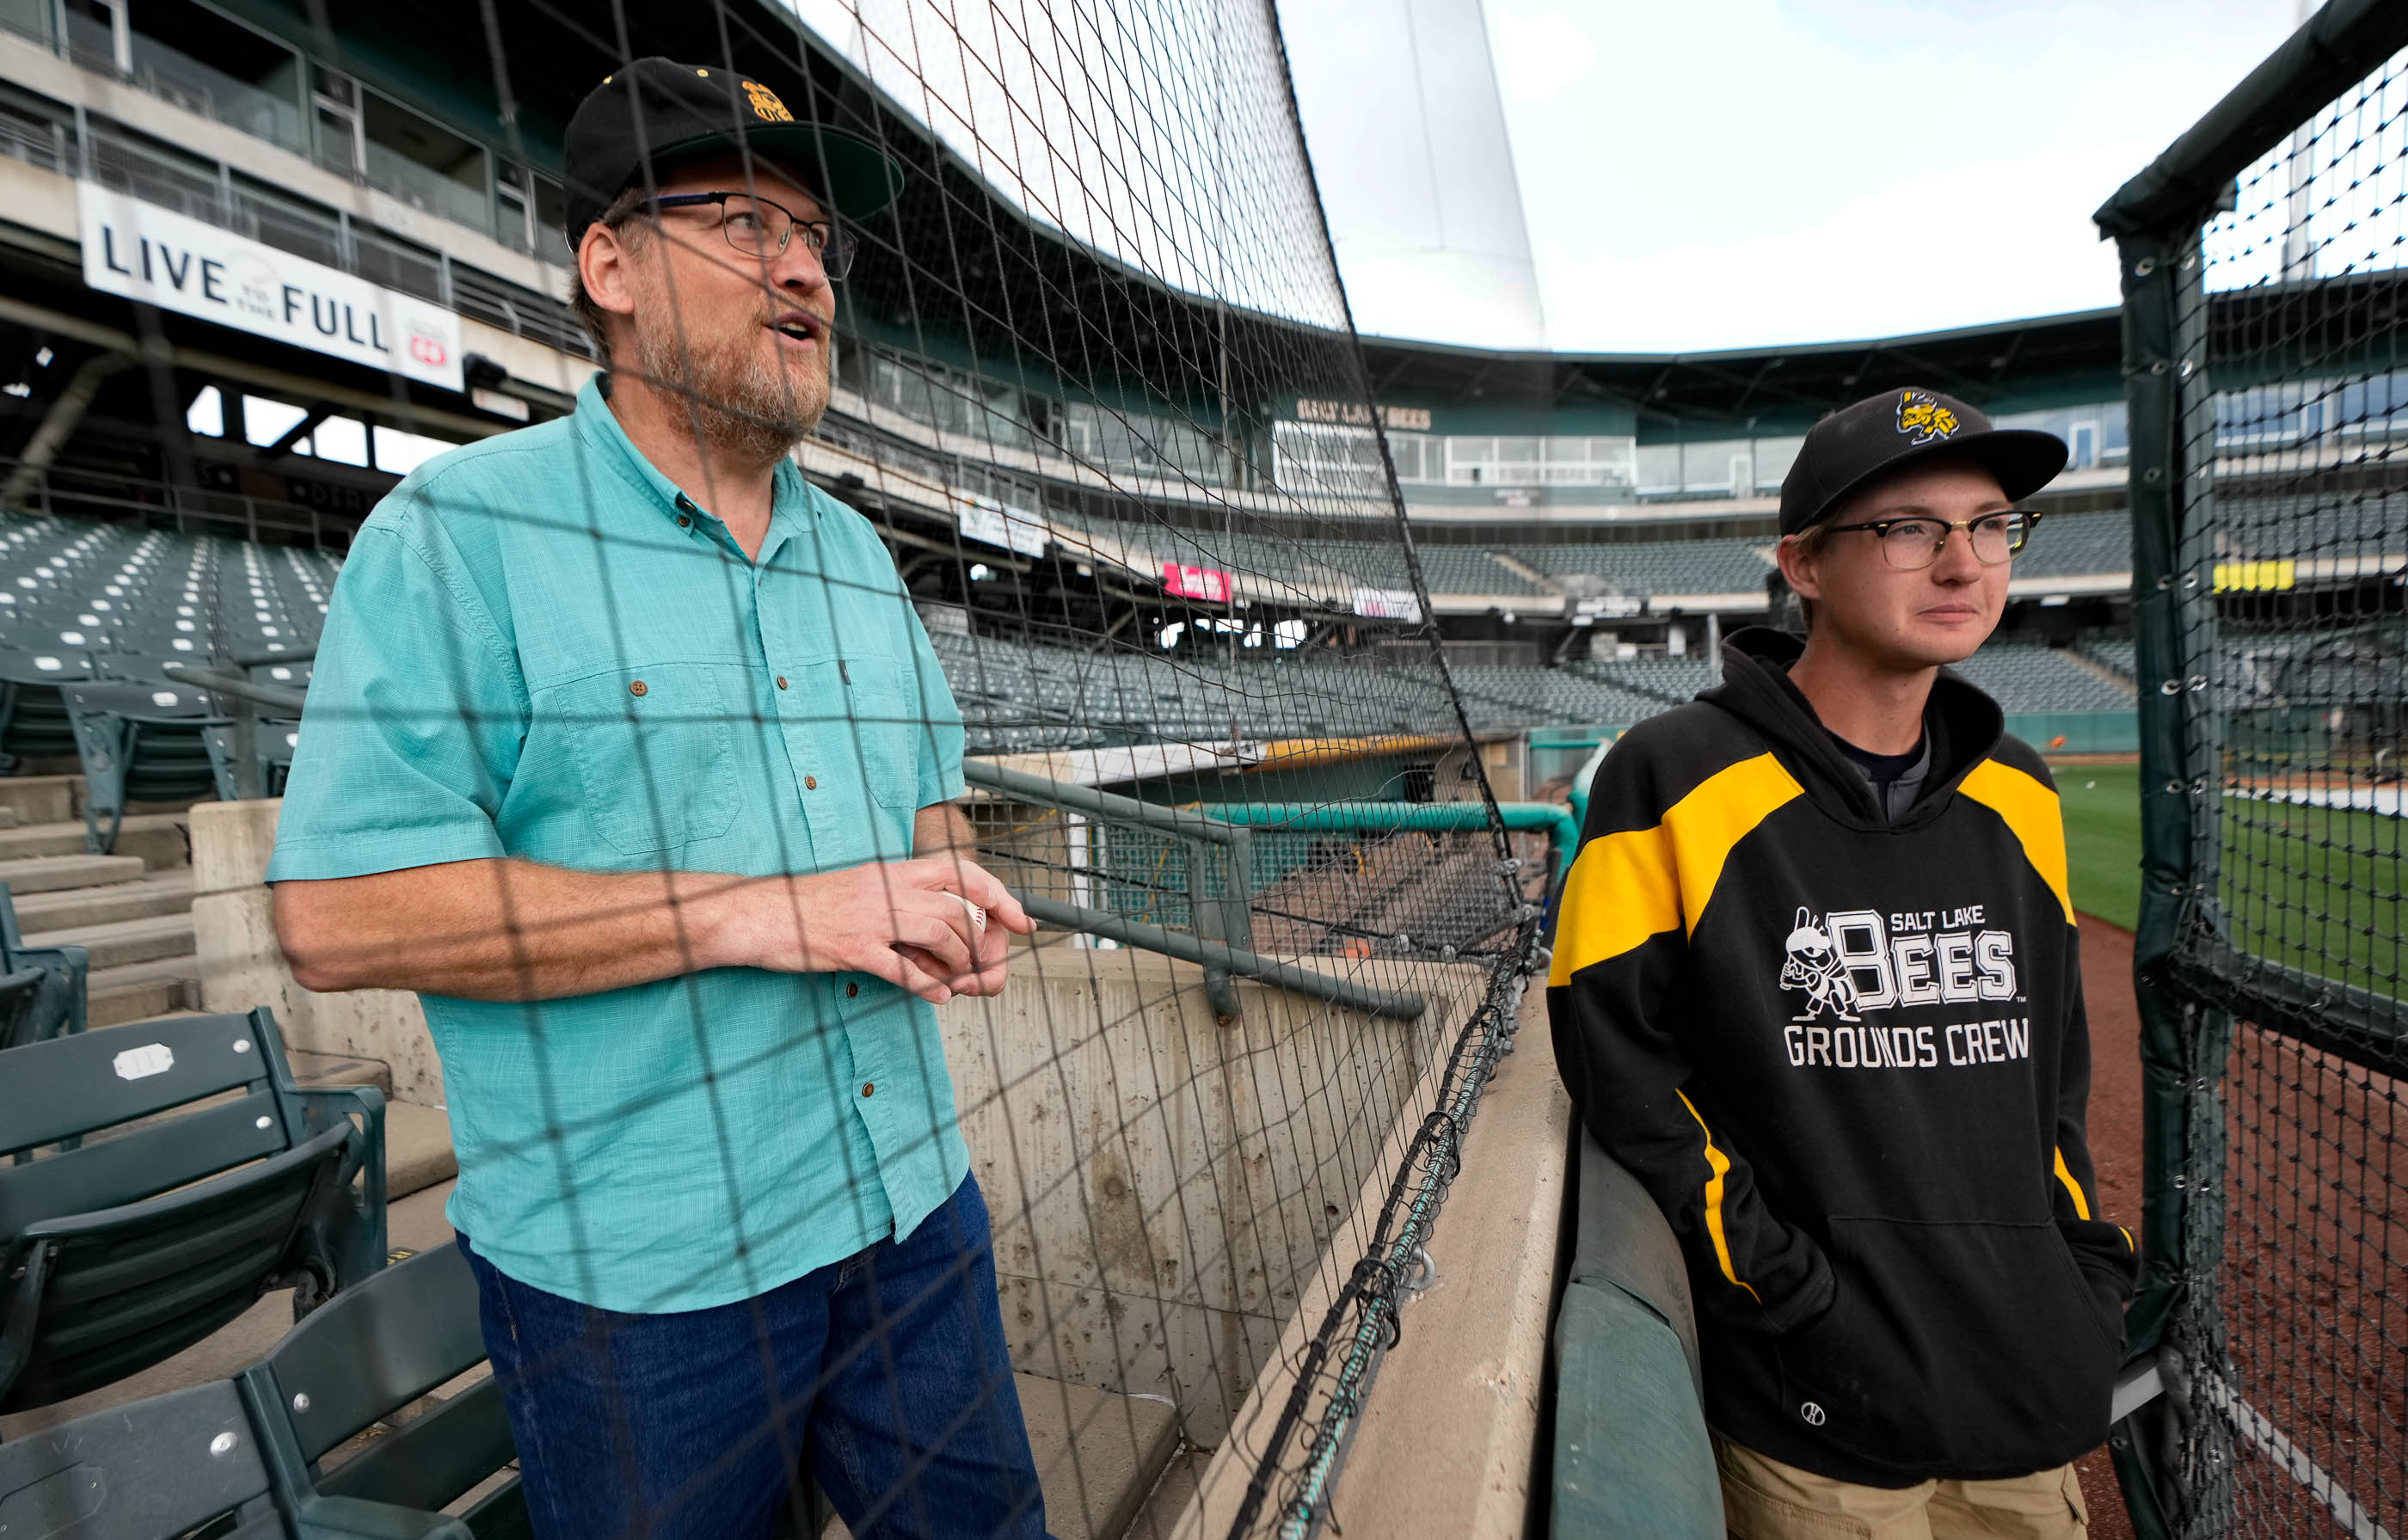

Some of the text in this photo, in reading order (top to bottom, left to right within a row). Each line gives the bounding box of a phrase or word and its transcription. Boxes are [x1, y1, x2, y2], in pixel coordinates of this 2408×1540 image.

[103, 226, 227, 303] LIVE
[282, 284, 390, 353] FULL
[1890, 905, 1986, 931] SALT LAKE
[1825, 909, 2018, 1013] BEES
[1784, 1017, 2029, 1069] GROUNDS CREW
